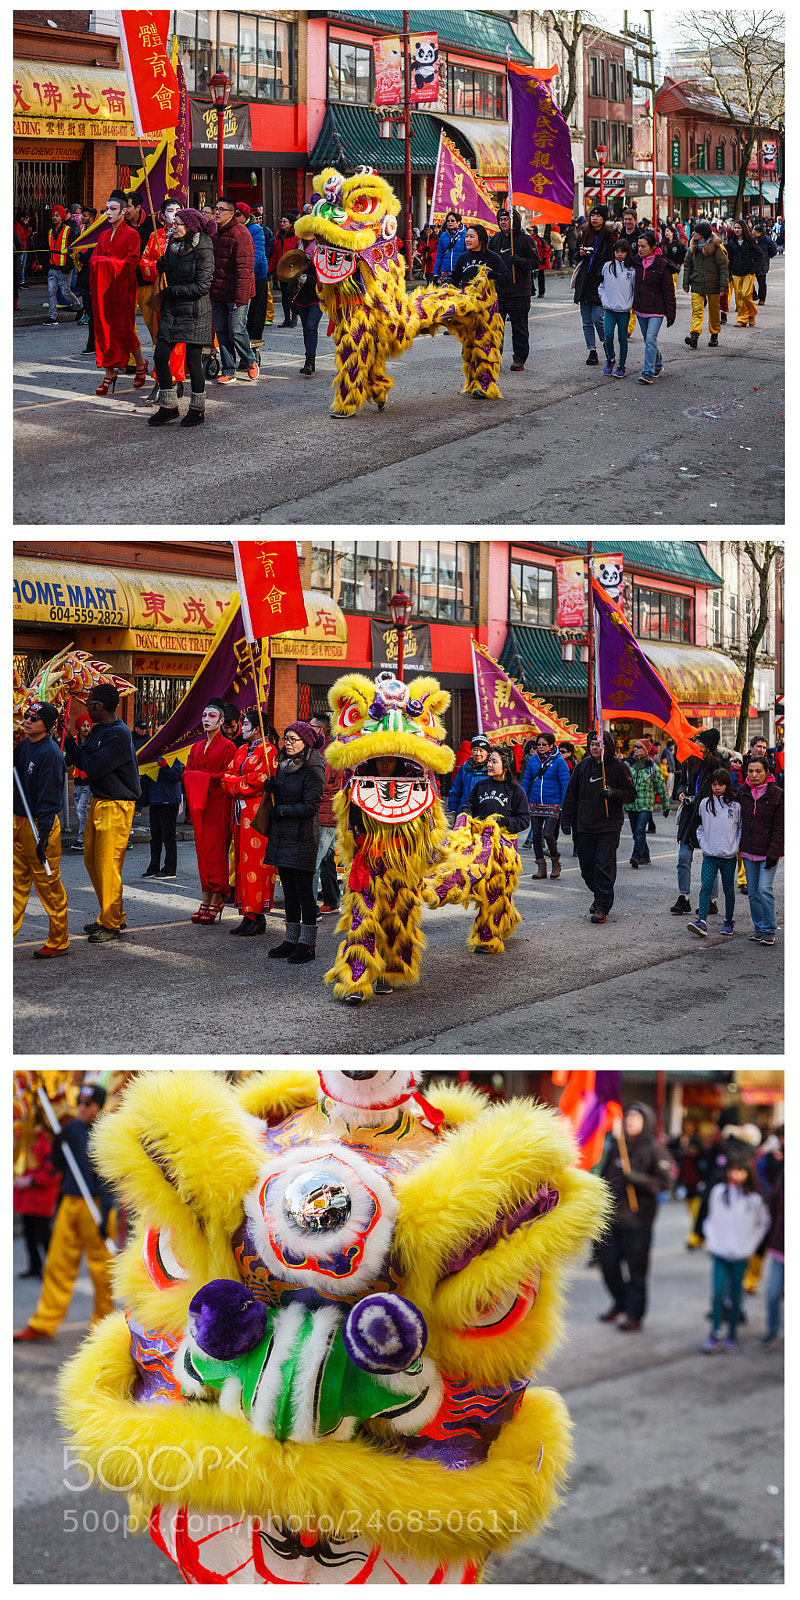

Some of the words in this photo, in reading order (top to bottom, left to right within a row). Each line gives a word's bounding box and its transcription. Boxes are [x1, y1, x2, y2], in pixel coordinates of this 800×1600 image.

[137, 10, 175, 111] 體育會
[203, 105, 233, 125] Vean
[206, 117, 239, 141] Suply
[31, 147, 54, 156] CHENG
[55, 147, 82, 157] TRADING
[255, 541, 287, 614] 育會
[13, 579, 65, 606] HOME
[66, 585, 117, 611] MART
[50, 606, 123, 625] 604-559-2822
[315, 608, 337, 636] 店
[135, 634, 159, 649] DONG
[160, 636, 187, 651] CHENG
[383, 625, 413, 645] Vean
[386, 638, 419, 661] Suply
[493, 679, 515, 718] 馬
